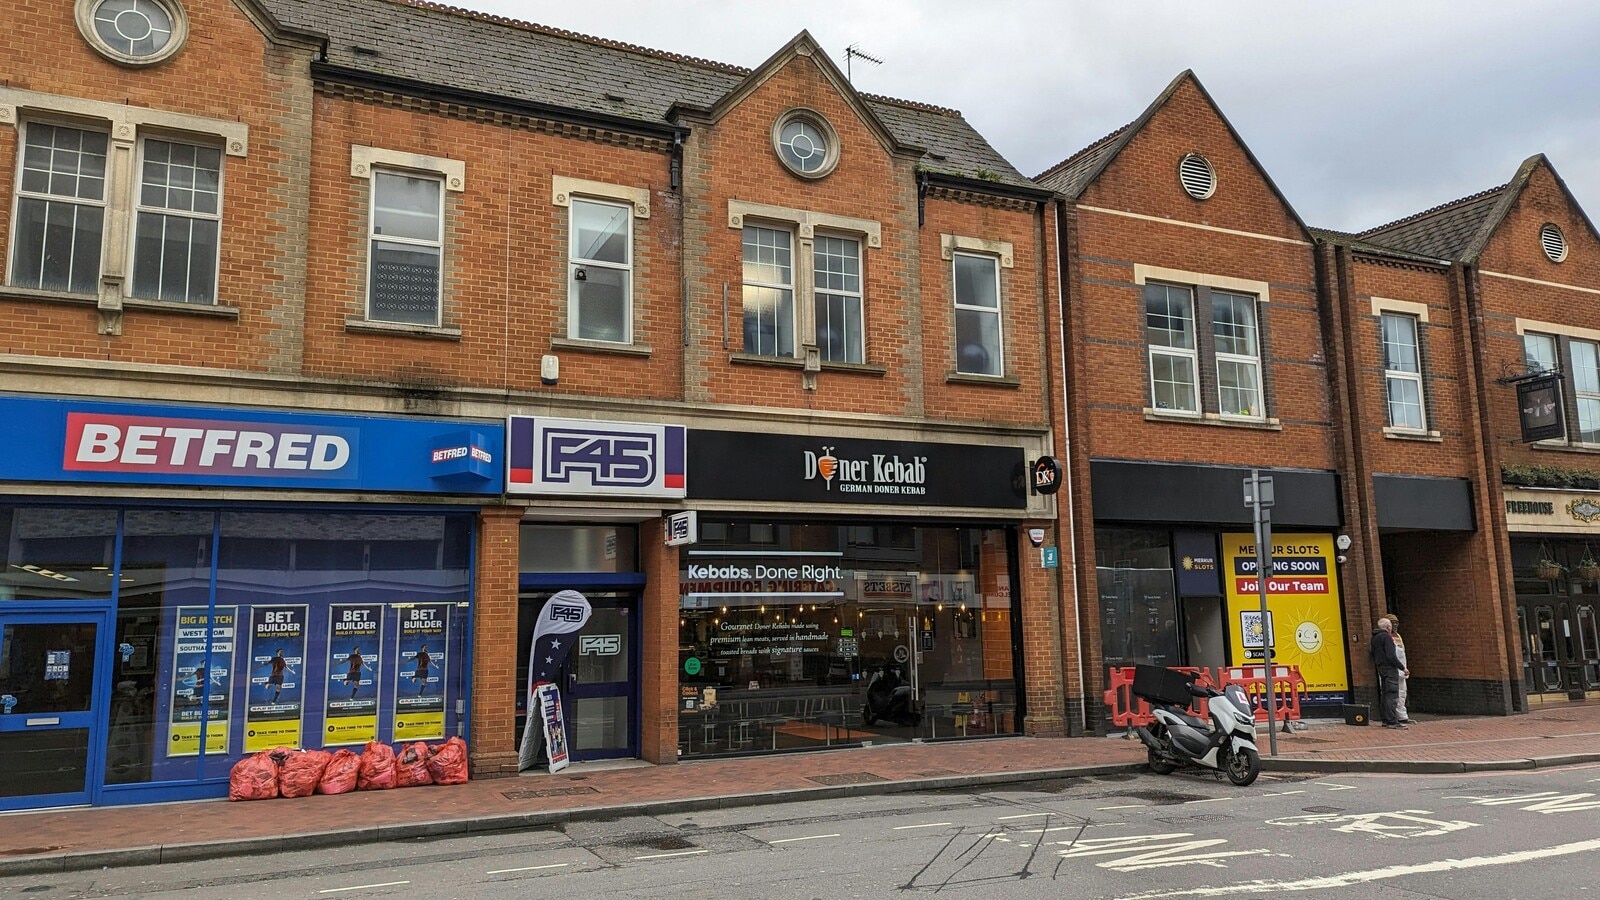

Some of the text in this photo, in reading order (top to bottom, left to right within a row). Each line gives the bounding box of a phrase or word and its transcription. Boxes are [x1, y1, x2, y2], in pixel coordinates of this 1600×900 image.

[76, 423, 350, 470] BETFRED
[433, 447, 467, 461] BETFRED
[471, 448, 492, 463] BETFRED
[542, 427, 657, 487] F45
[872, 454, 925, 484] Kebab
[840, 484, 926, 495] GERMAN DONER KEBAB
[673, 517, 689, 540] F45
[1239, 546, 1320, 555] MEUR SLOTS
[1241, 561, 1320, 571] OPNG SOON
[688, 565, 844, 582] Kebabs. Done Right.
[1241, 581, 1325, 591] Joi Our Team
[265, 611, 294, 623] BET
[343, 610, 370, 621] BET
[411, 609, 436, 620] BET
[550, 604, 584, 622] F45
[181, 616, 232, 624] BIG MTCH
[335, 621, 376, 630] BUILDER
[404, 620, 442, 629] BUILDER
[257, 623, 301, 632] BUILDER
[720, 622, 753, 631] Gourmet
[710, 635, 741, 645] premium
[795, 632, 829, 641] handmade
[579, 634, 621, 656] F45
[771, 646, 802, 656] signature
